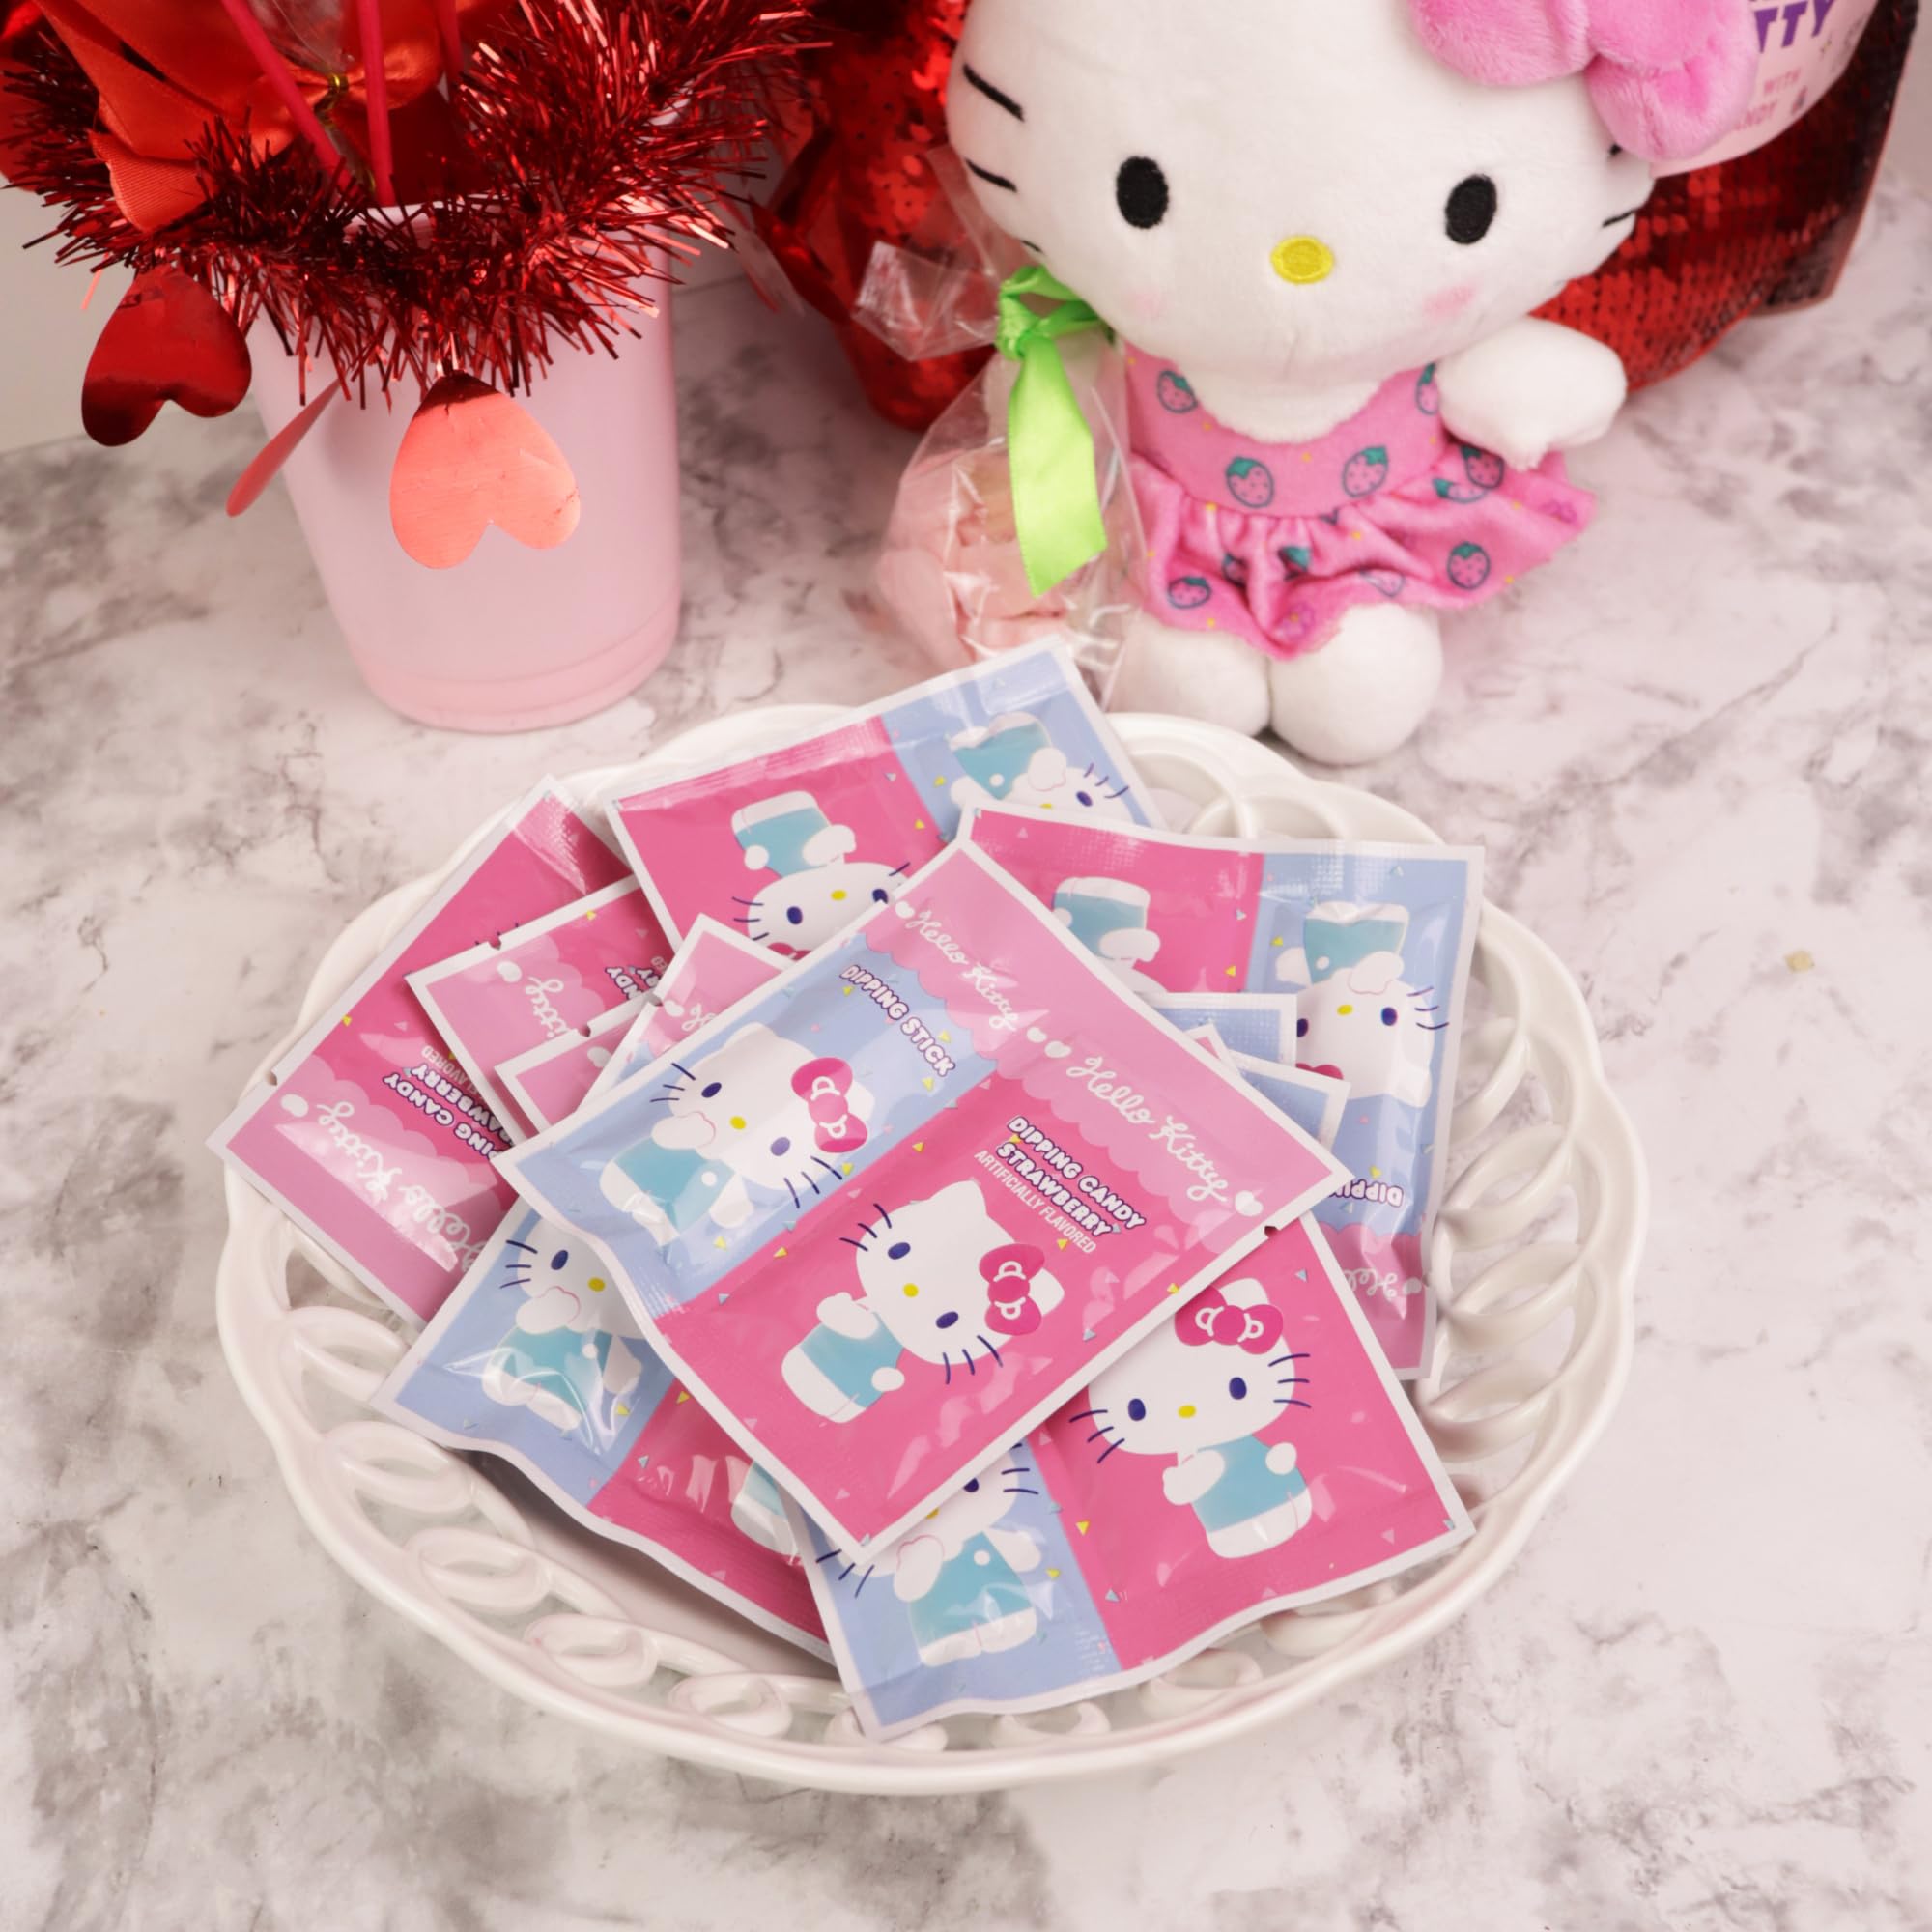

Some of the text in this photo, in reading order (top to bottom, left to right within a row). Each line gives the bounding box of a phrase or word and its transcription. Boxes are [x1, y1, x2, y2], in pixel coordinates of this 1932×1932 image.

[1754, 0, 1835, 53] TTY
[525, 976, 580, 1038] itty
[605, 966, 643, 1001] NDY
[905, 910, 1018, 1032] Hello Kitty
[839, 965, 955, 1077] DIPPING STICK
[383, 1073, 454, 1126] CANDY
[411, 1064, 515, 1147] RAWBERRY
[1067, 1056, 1228, 1205] Hello Kitty
[317, 1101, 402, 1205] Kitty
[996, 1142, 1113, 1237] STRAWBERRY
[1007, 1115, 1147, 1230] DIPPING CANDY
[1330, 1179, 1404, 1207] DIPPI
[974, 1150, 1097, 1255] ARTIFICIALLY FLAVORED
[1345, 1268, 1397, 1297] Hel
